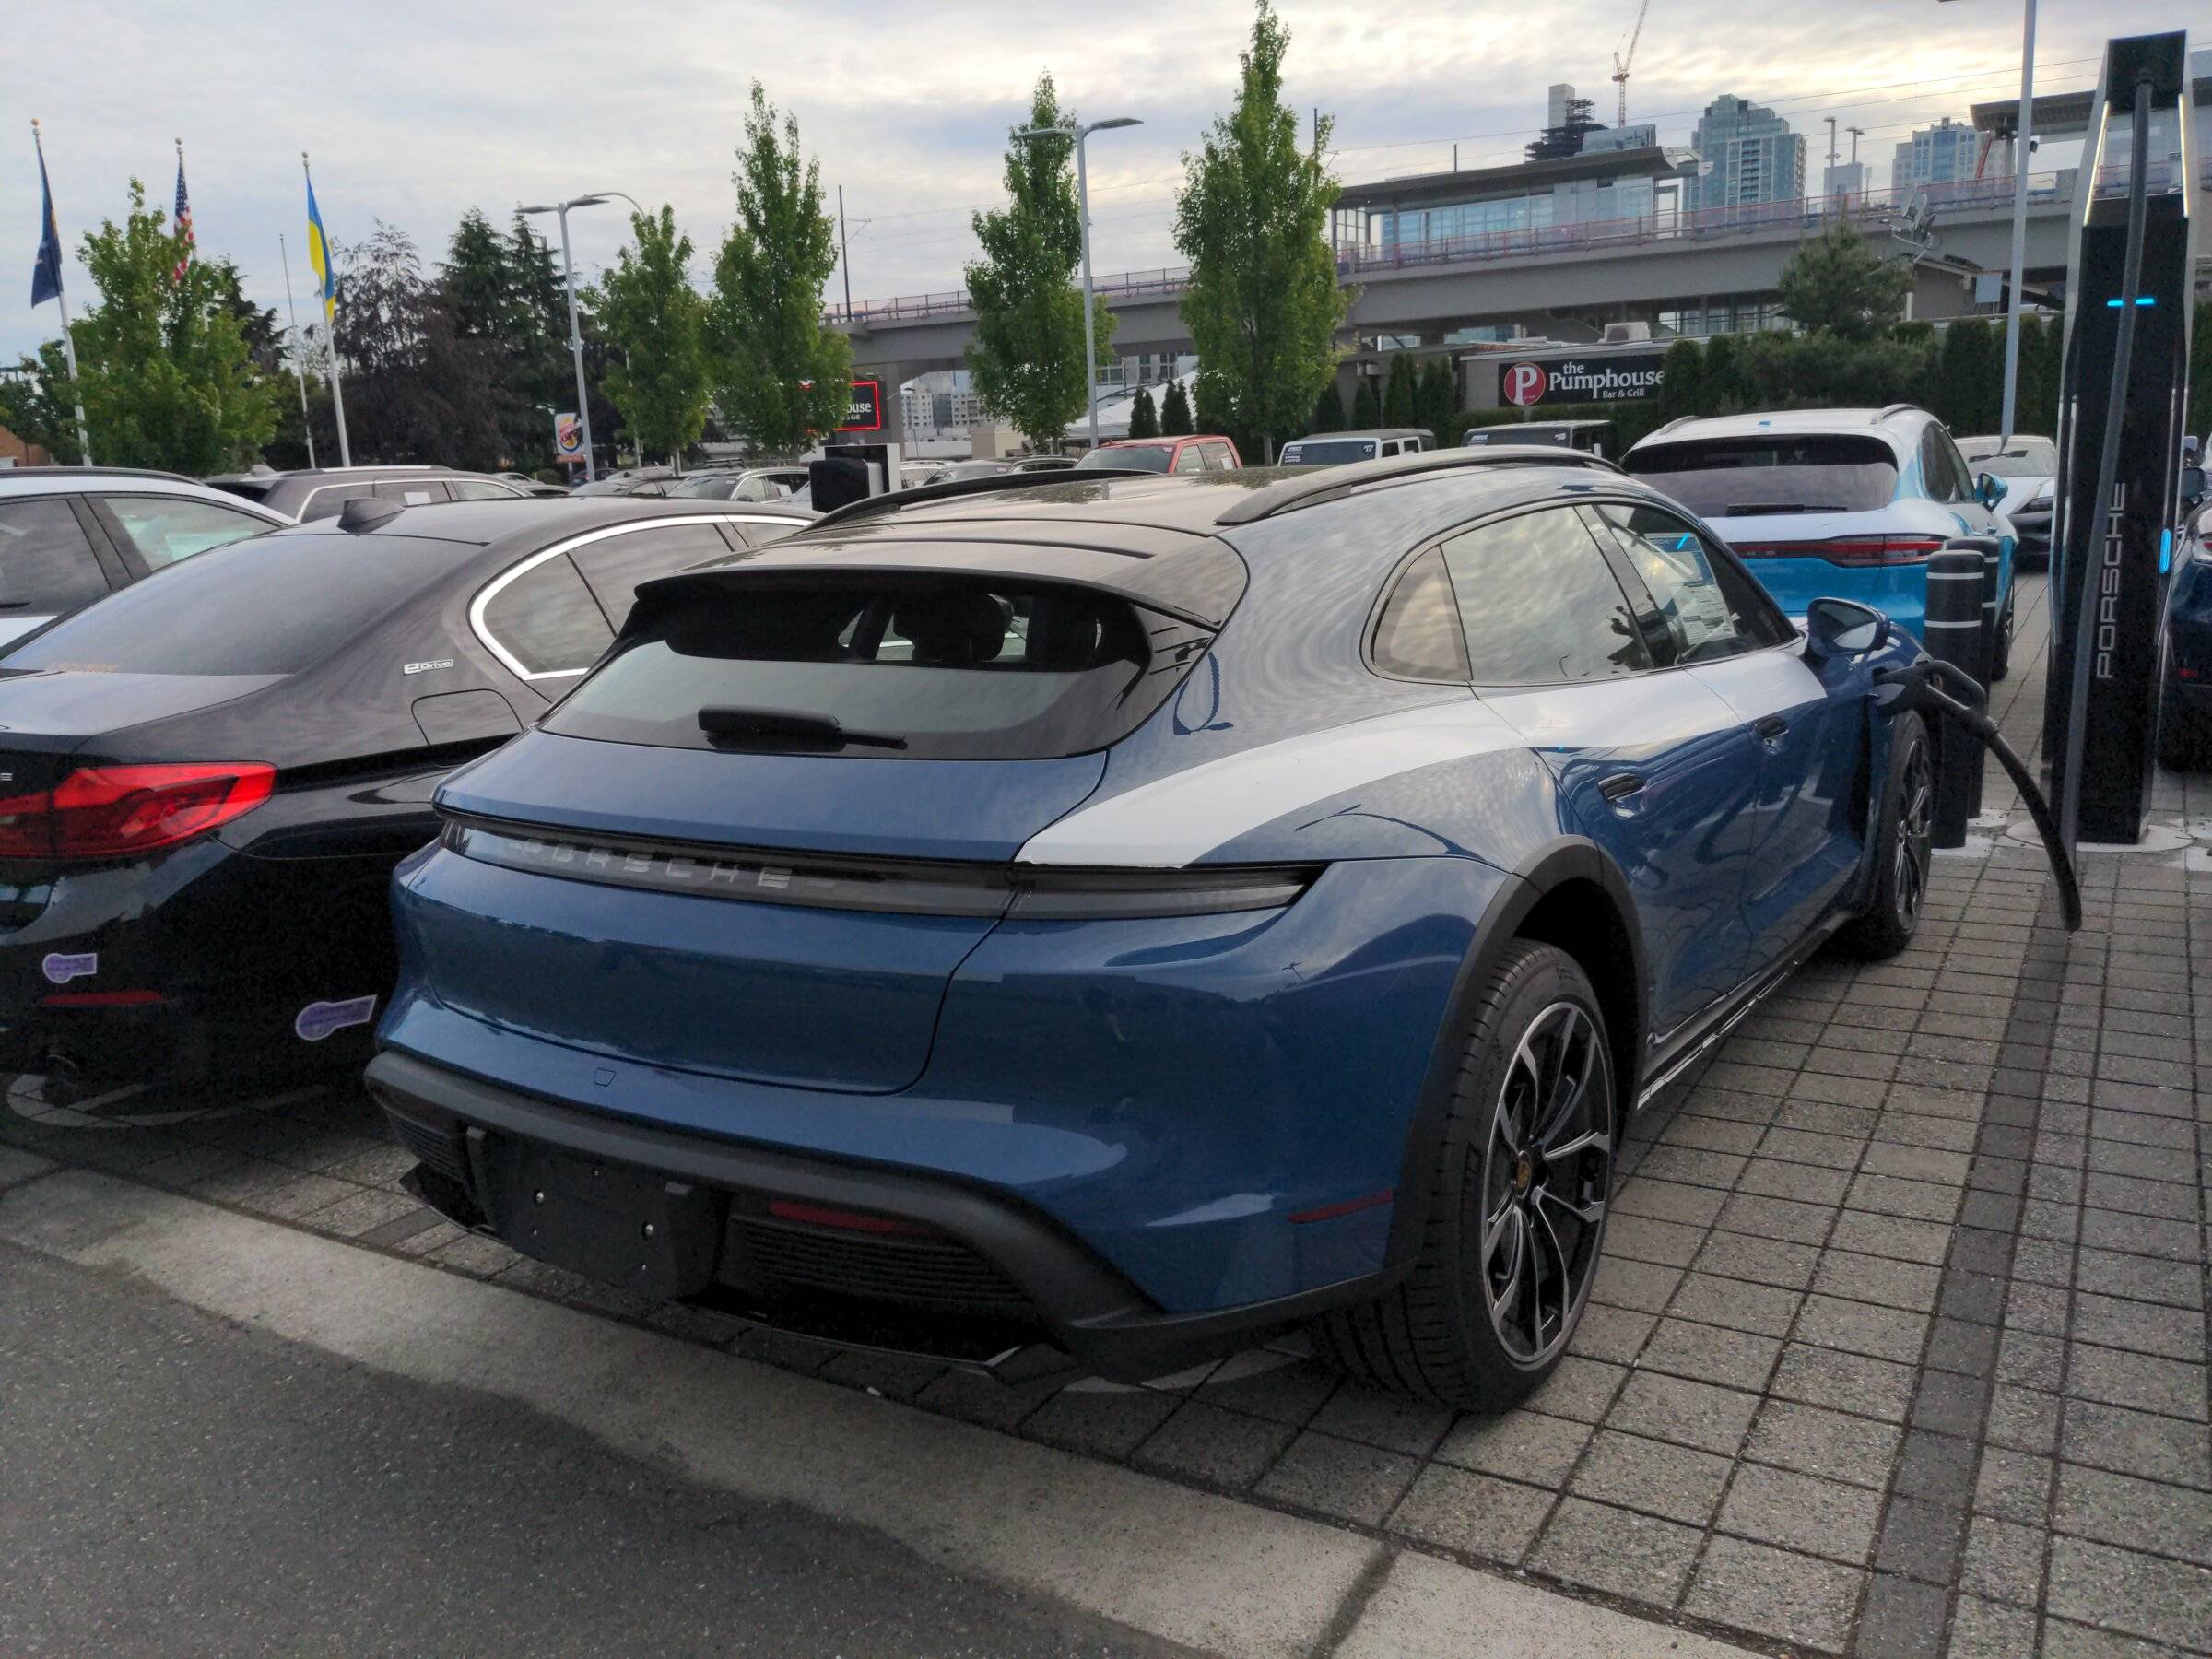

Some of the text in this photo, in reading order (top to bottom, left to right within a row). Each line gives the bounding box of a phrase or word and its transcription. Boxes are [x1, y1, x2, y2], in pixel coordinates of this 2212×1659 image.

[1562, 362, 1585, 374] the
[1548, 369, 1665, 399] Pumphouse
[1602, 387, 1644, 399] Bar & Grill
[2096, 482, 2126, 678] PORSCHE
[519, 838, 792, 888] PORSCHE
